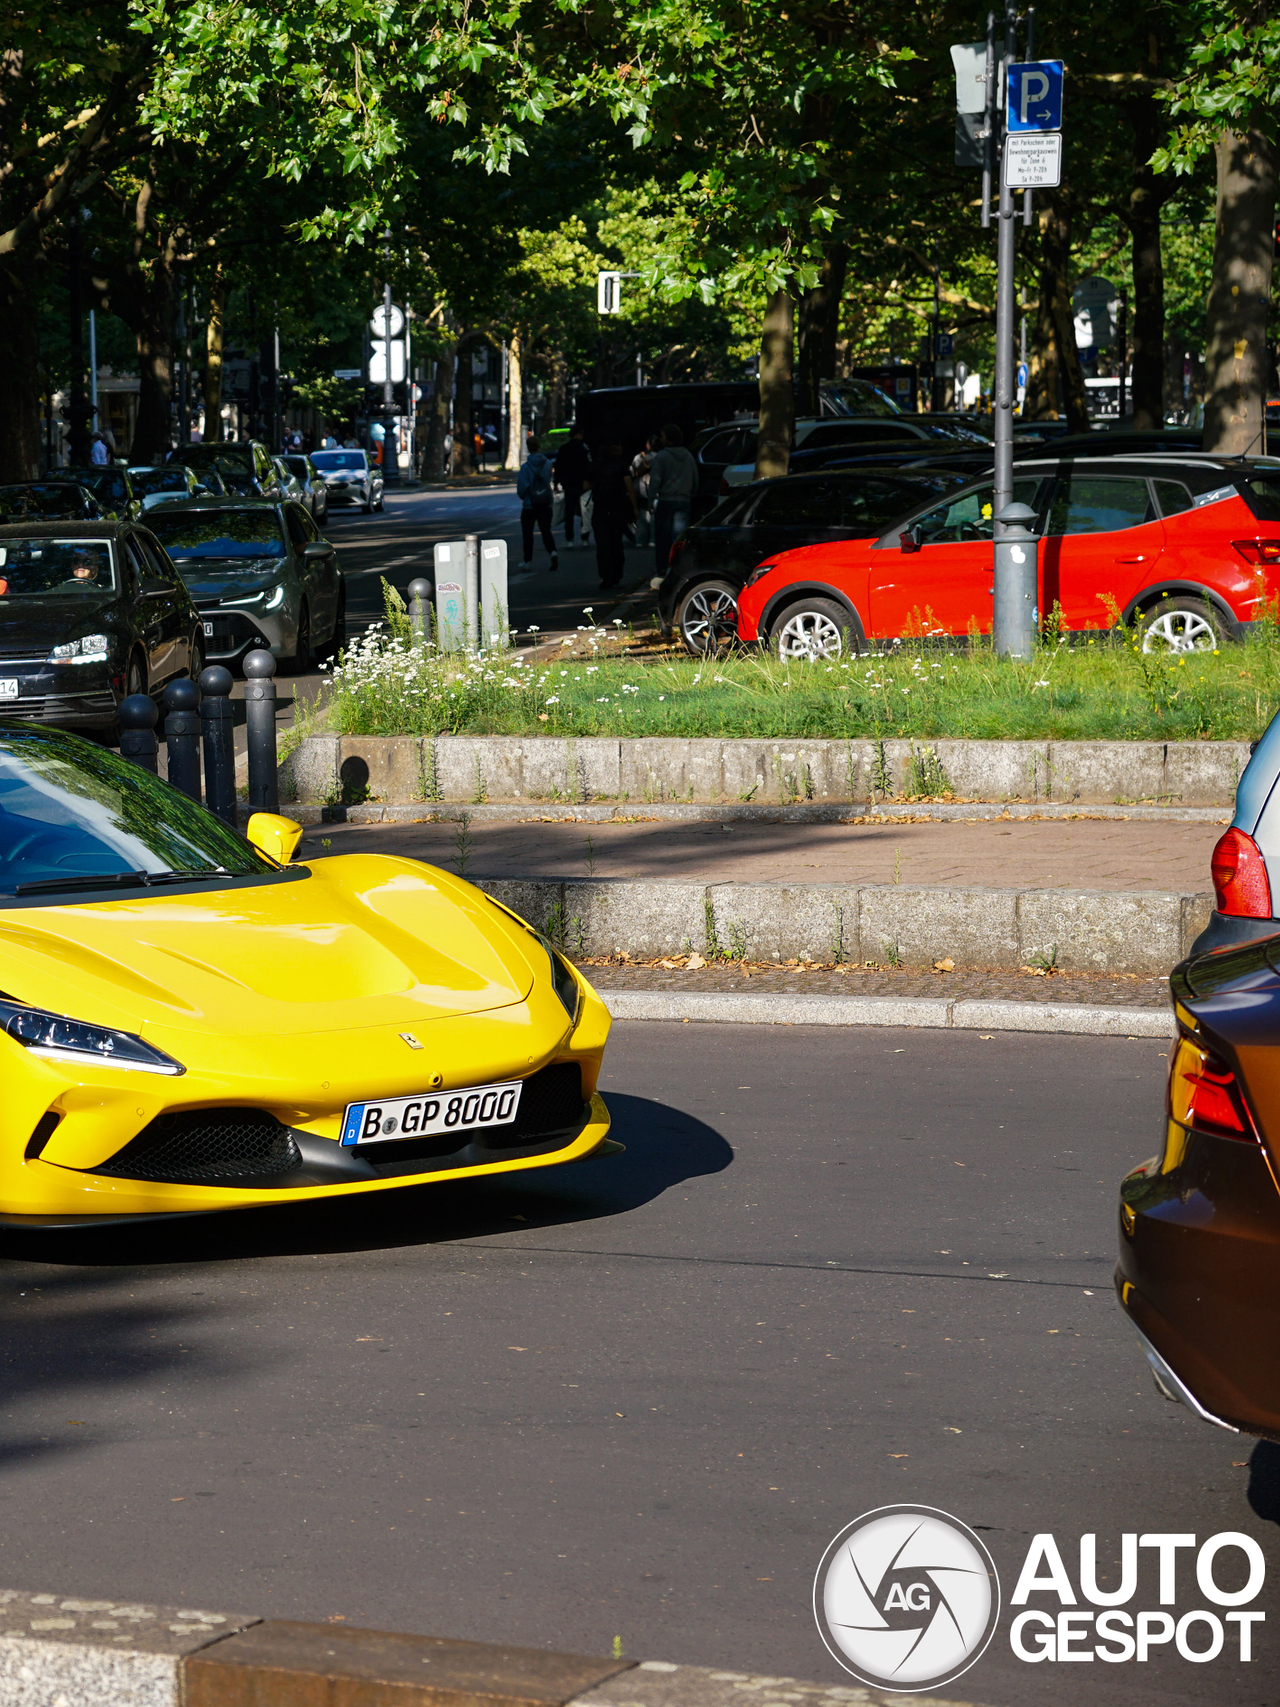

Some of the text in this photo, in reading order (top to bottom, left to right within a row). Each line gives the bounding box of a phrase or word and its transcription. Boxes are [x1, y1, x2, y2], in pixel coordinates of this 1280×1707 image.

[1020, 71, 1050, 123] P
[347, 1089, 516, 1139] D B GP 8000
